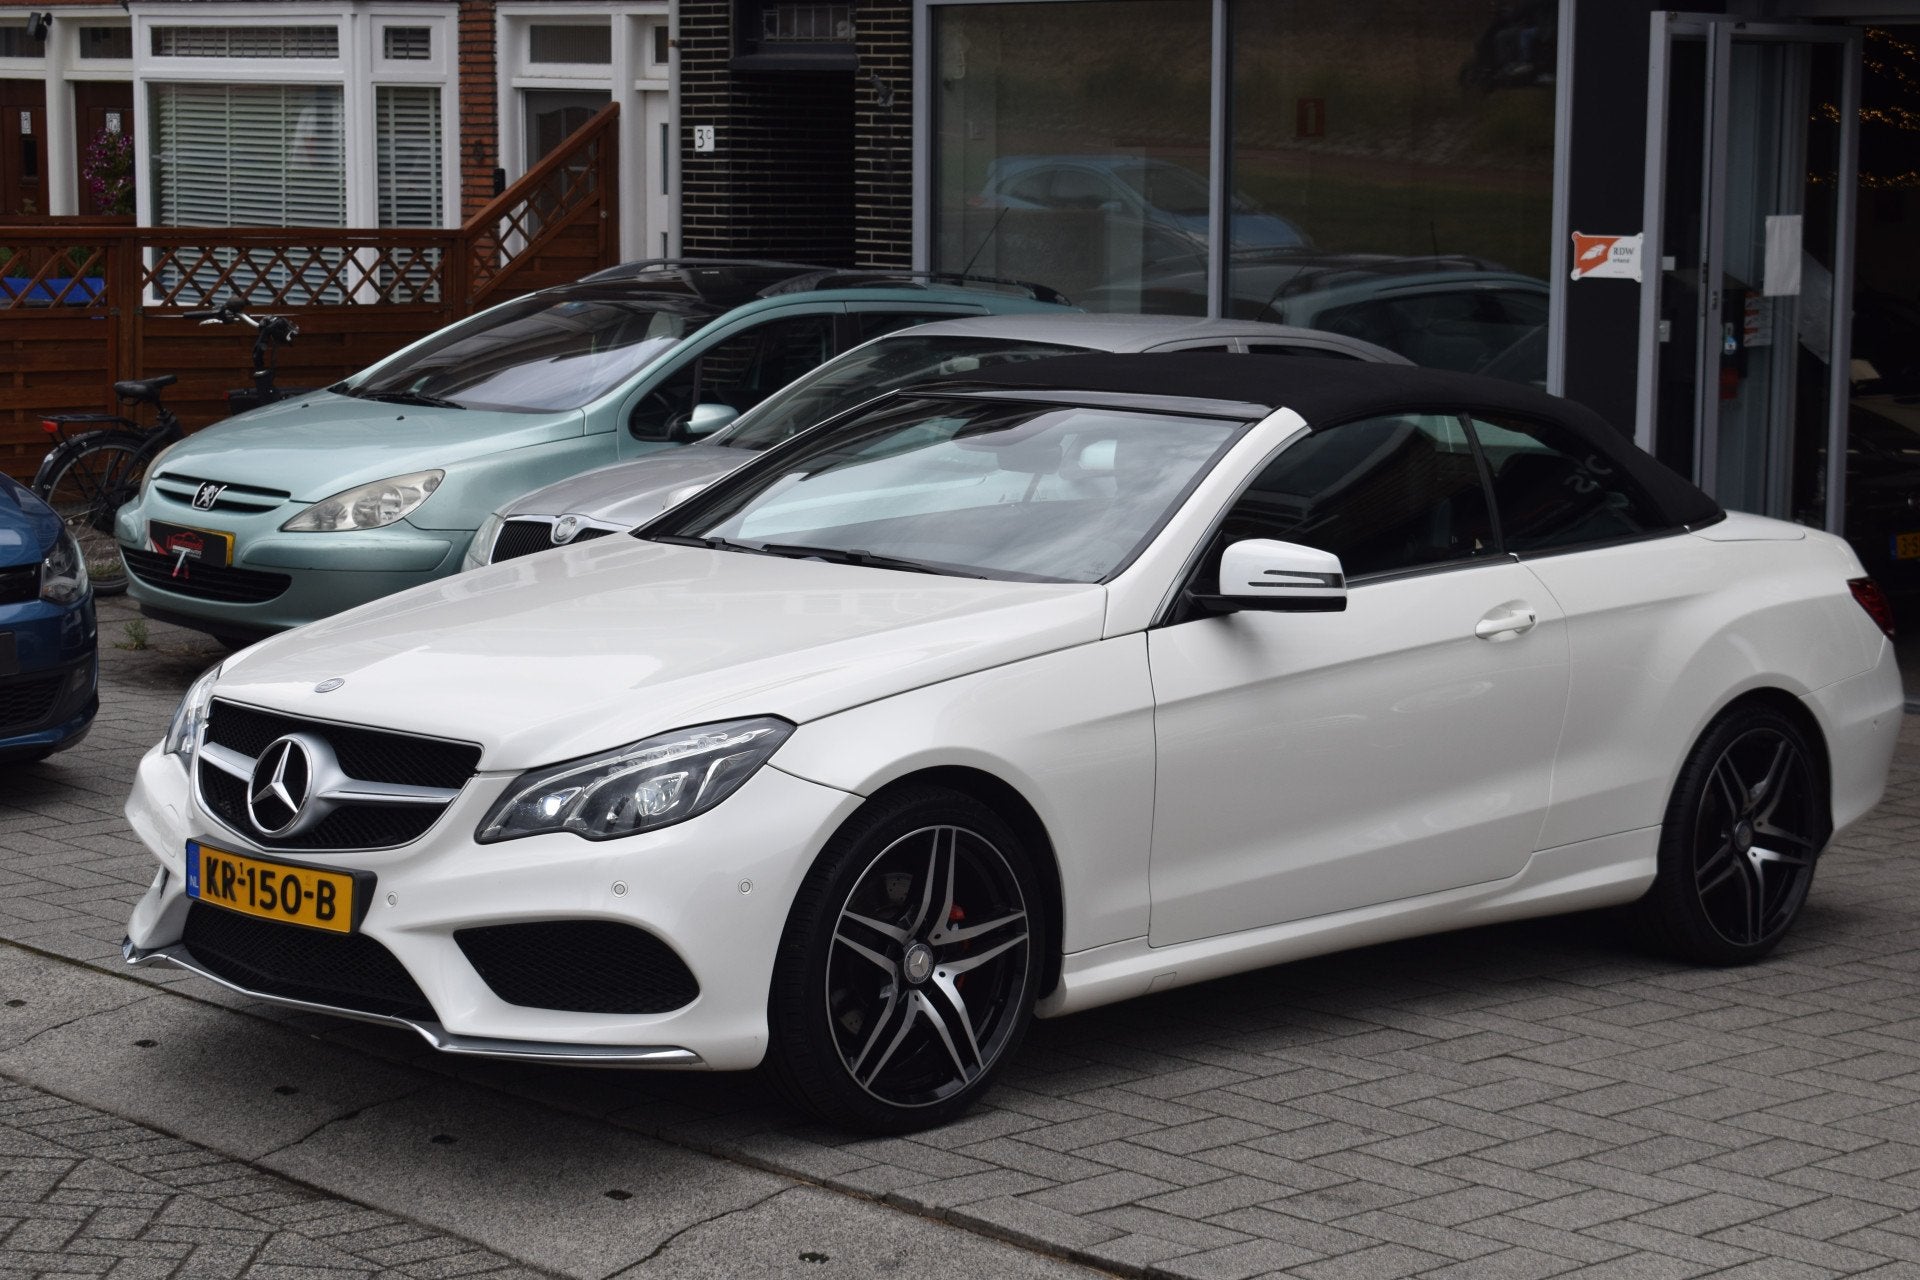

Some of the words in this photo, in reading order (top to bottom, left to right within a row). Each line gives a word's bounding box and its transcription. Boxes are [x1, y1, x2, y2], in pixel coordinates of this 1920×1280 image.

[1613, 247, 1634, 255] RDW
[190, 875, 199, 888] NL
[205, 856, 338, 921] KR-150-B
